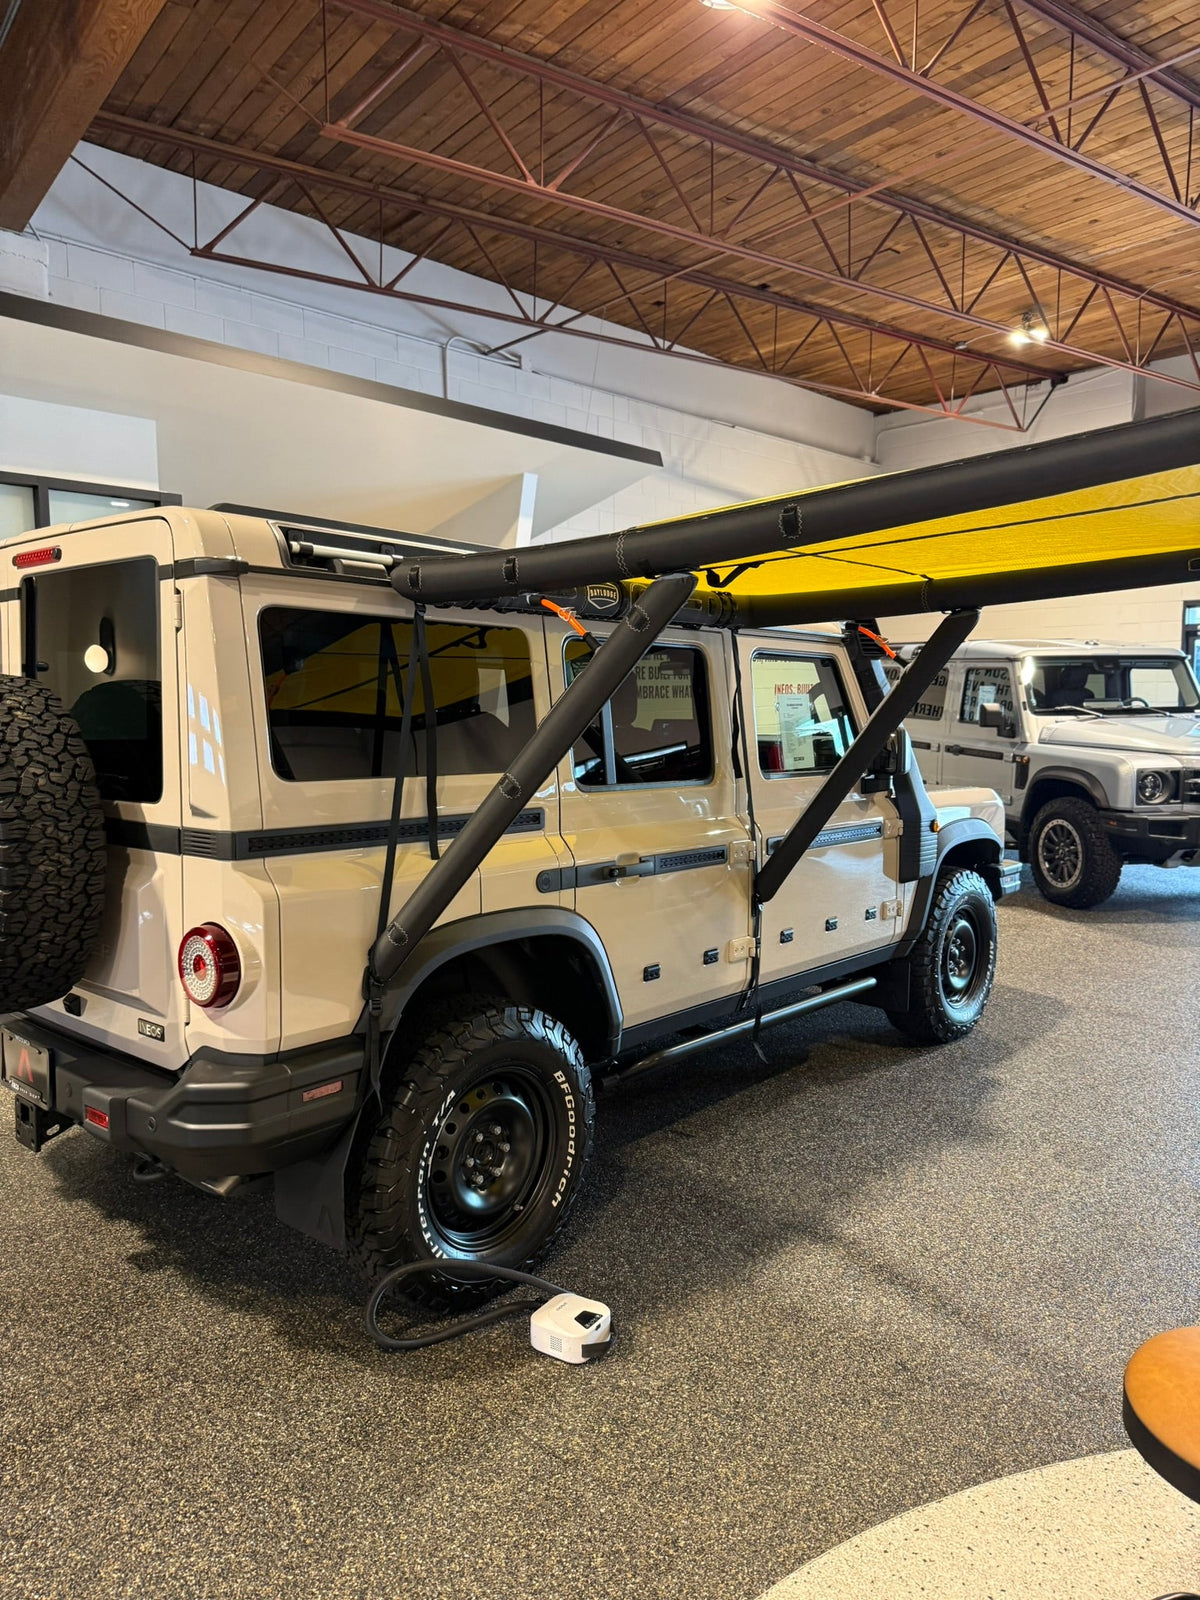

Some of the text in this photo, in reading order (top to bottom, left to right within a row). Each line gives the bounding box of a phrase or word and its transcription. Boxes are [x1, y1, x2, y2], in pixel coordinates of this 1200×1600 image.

[590, 588, 617, 599] DAYLODGE
[139, 1021, 162, 1038] INEOS
[432, 1089, 456, 1127] T/A
[553, 1070, 576, 1207] BFGoodrich
